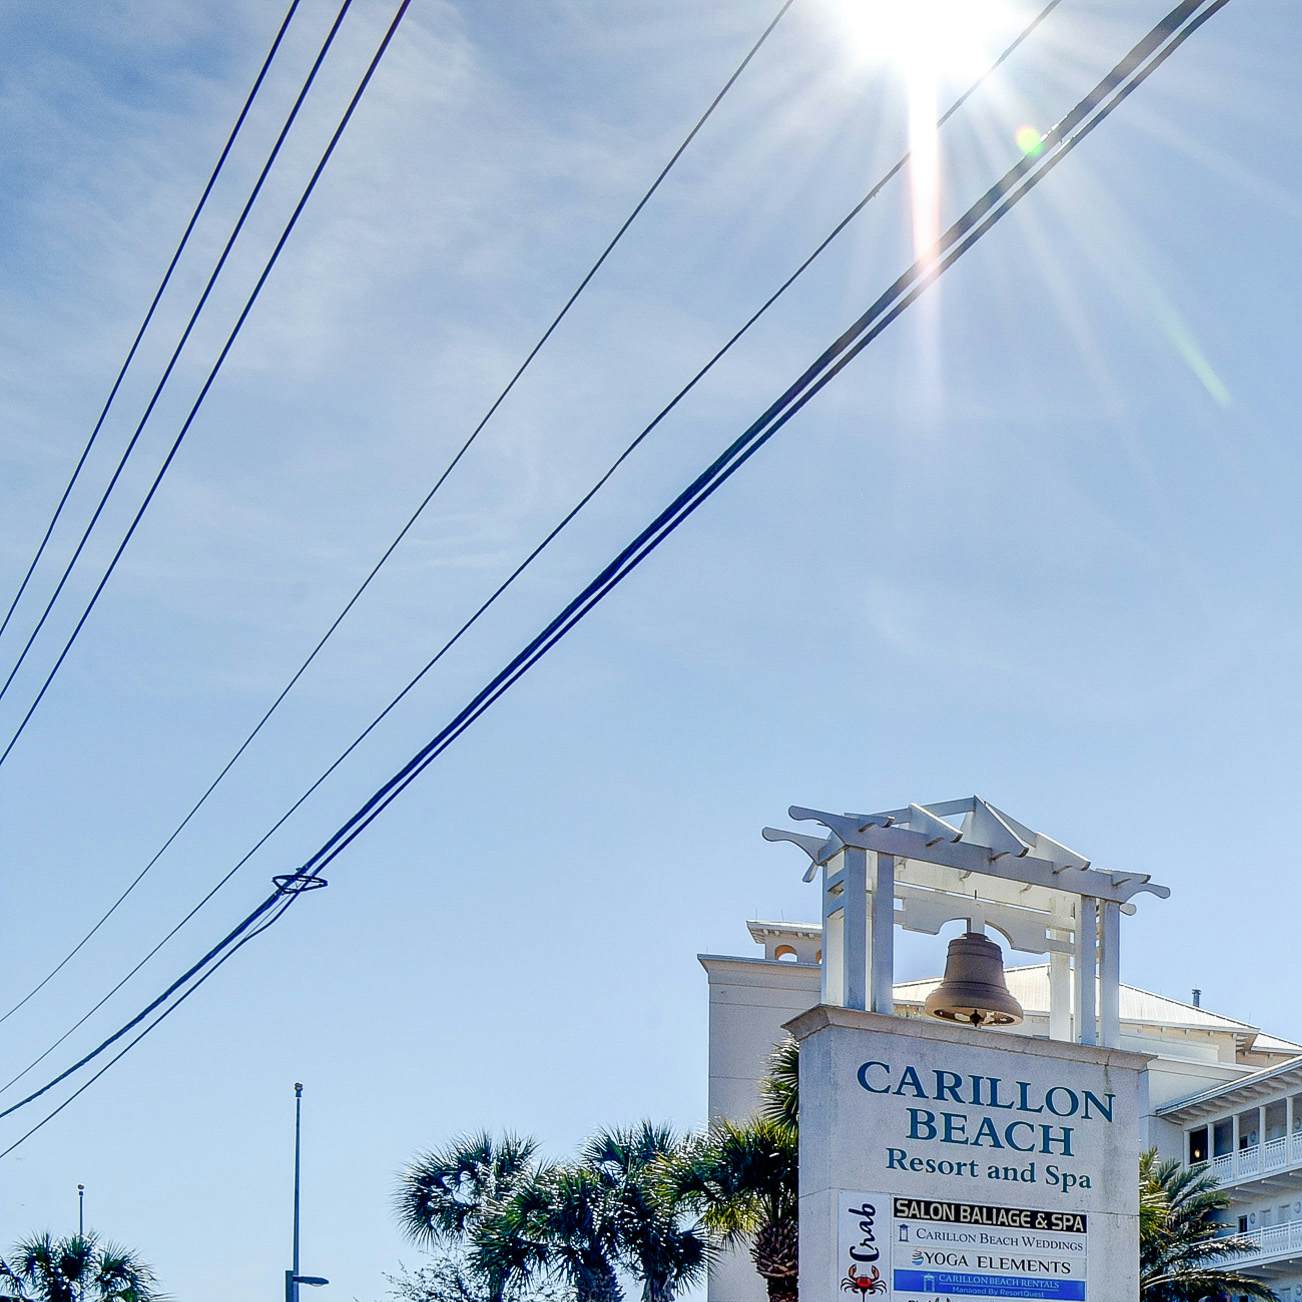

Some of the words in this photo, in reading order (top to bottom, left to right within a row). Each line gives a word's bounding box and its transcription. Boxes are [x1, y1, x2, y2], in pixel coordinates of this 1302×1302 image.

[857, 1061, 1116, 1122] CARILLON
[906, 1107, 1074, 1157] BEACH
[886, 1147, 979, 1178] Resort
[987, 1162, 1036, 1183] and
[1045, 1165, 1092, 1193] Spa
[896, 1200, 955, 1221] SALON
[960, 1205, 1031, 1228] BALIAGE
[1035, 1213, 1048, 1229] &
[1051, 1214, 1084, 1232] SPA
[848, 1203, 880, 1262] Crab
[916, 1228, 976, 1244] CARILLON
[980, 1232, 1018, 1247] BEACH
[1022, 1236, 1084, 1251] WEDDINGS
[923, 1252, 969, 1268] YOGA
[977, 1255, 1071, 1275] ELEMENTS
[939, 1274, 989, 1285] CARILLON
[989, 1276, 1020, 1287] BEACH
[1021, 1279, 1060, 1289] RENTALS
[952, 1286, 987, 1295] Managed
[988, 1288, 999, 1296] By
